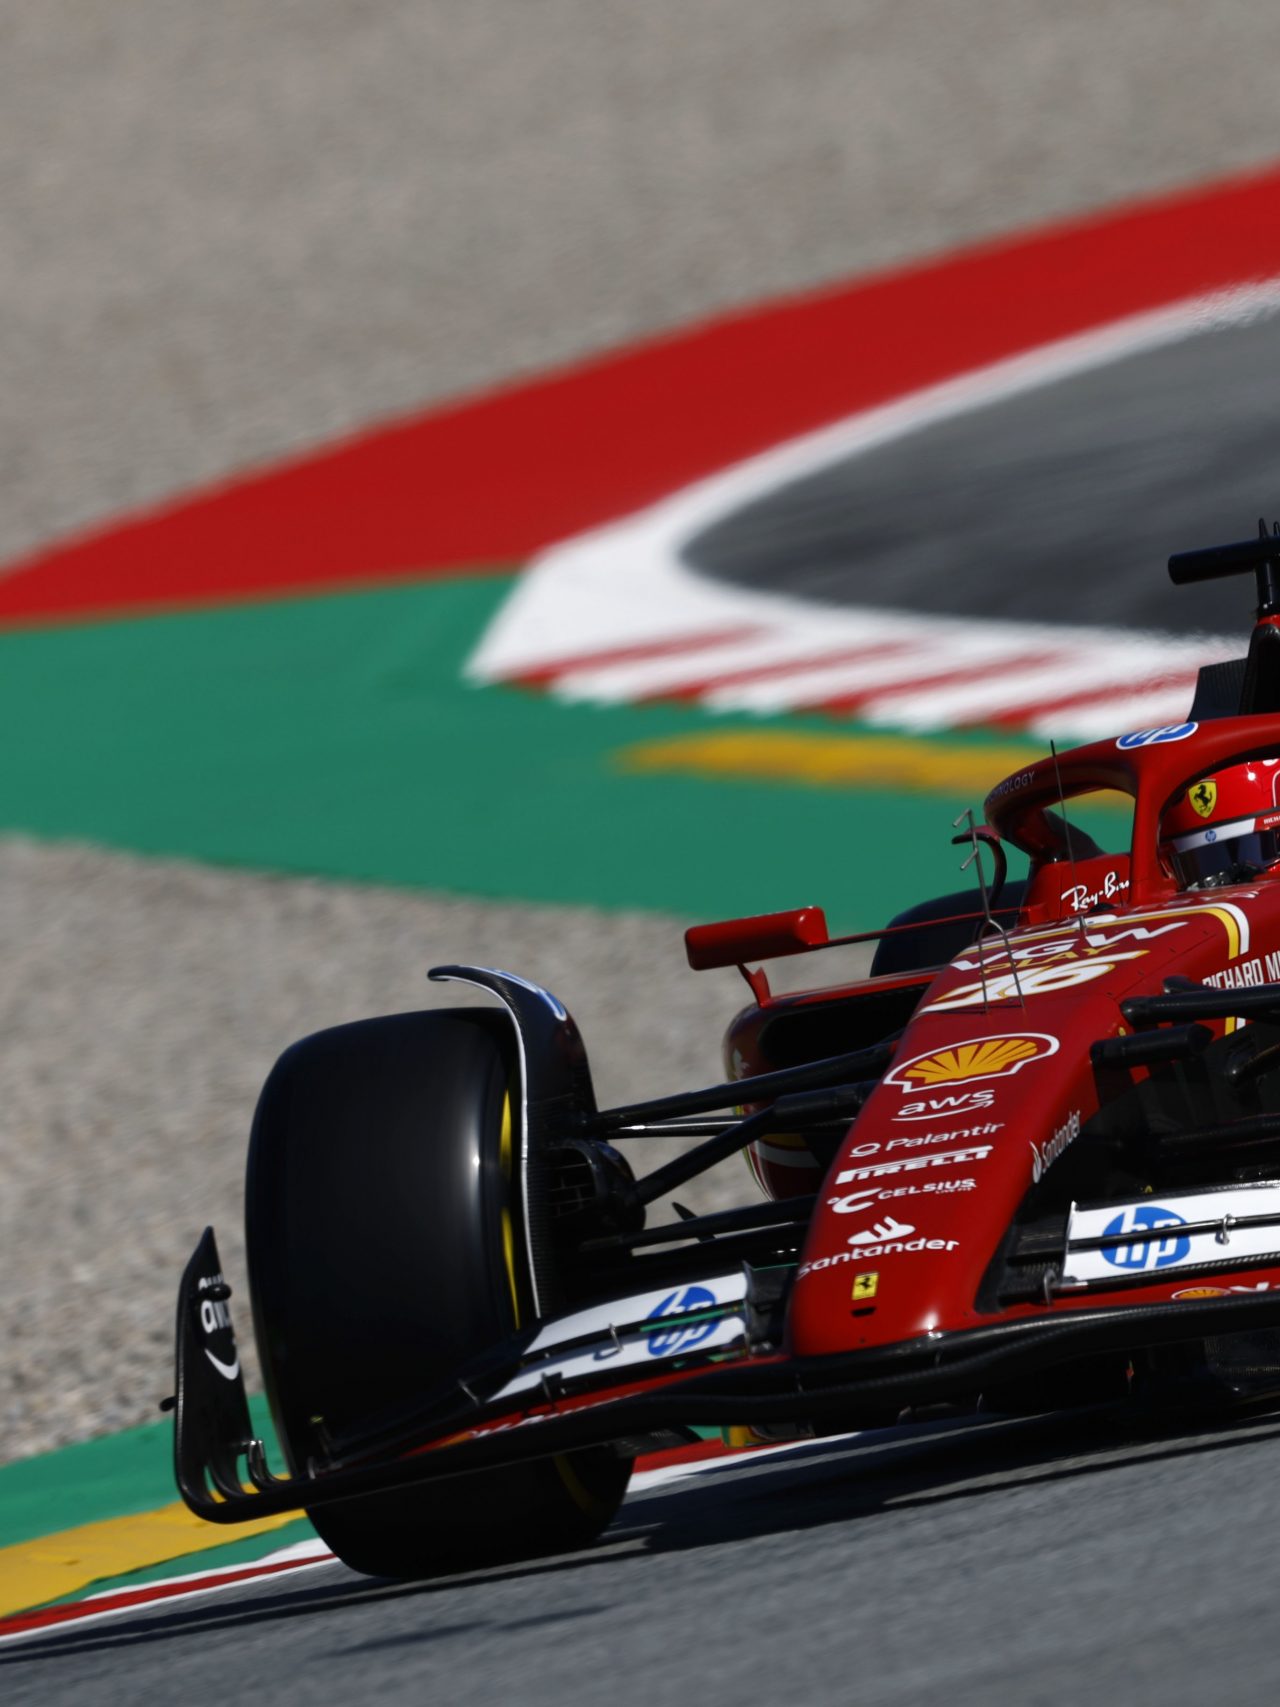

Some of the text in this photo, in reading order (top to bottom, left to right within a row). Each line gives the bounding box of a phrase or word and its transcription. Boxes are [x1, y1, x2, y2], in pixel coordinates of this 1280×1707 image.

[950, 921, 1189, 971] VGW
[979, 943, 1120, 976] PLAY
[897, 1089, 995, 1118] aws
[885, 1122, 1005, 1151] Palantir
[835, 1145, 994, 1185] PIRELLI
[877, 1178, 977, 1200] CELSIUS
[1108, 1206, 1186, 1269] hp
